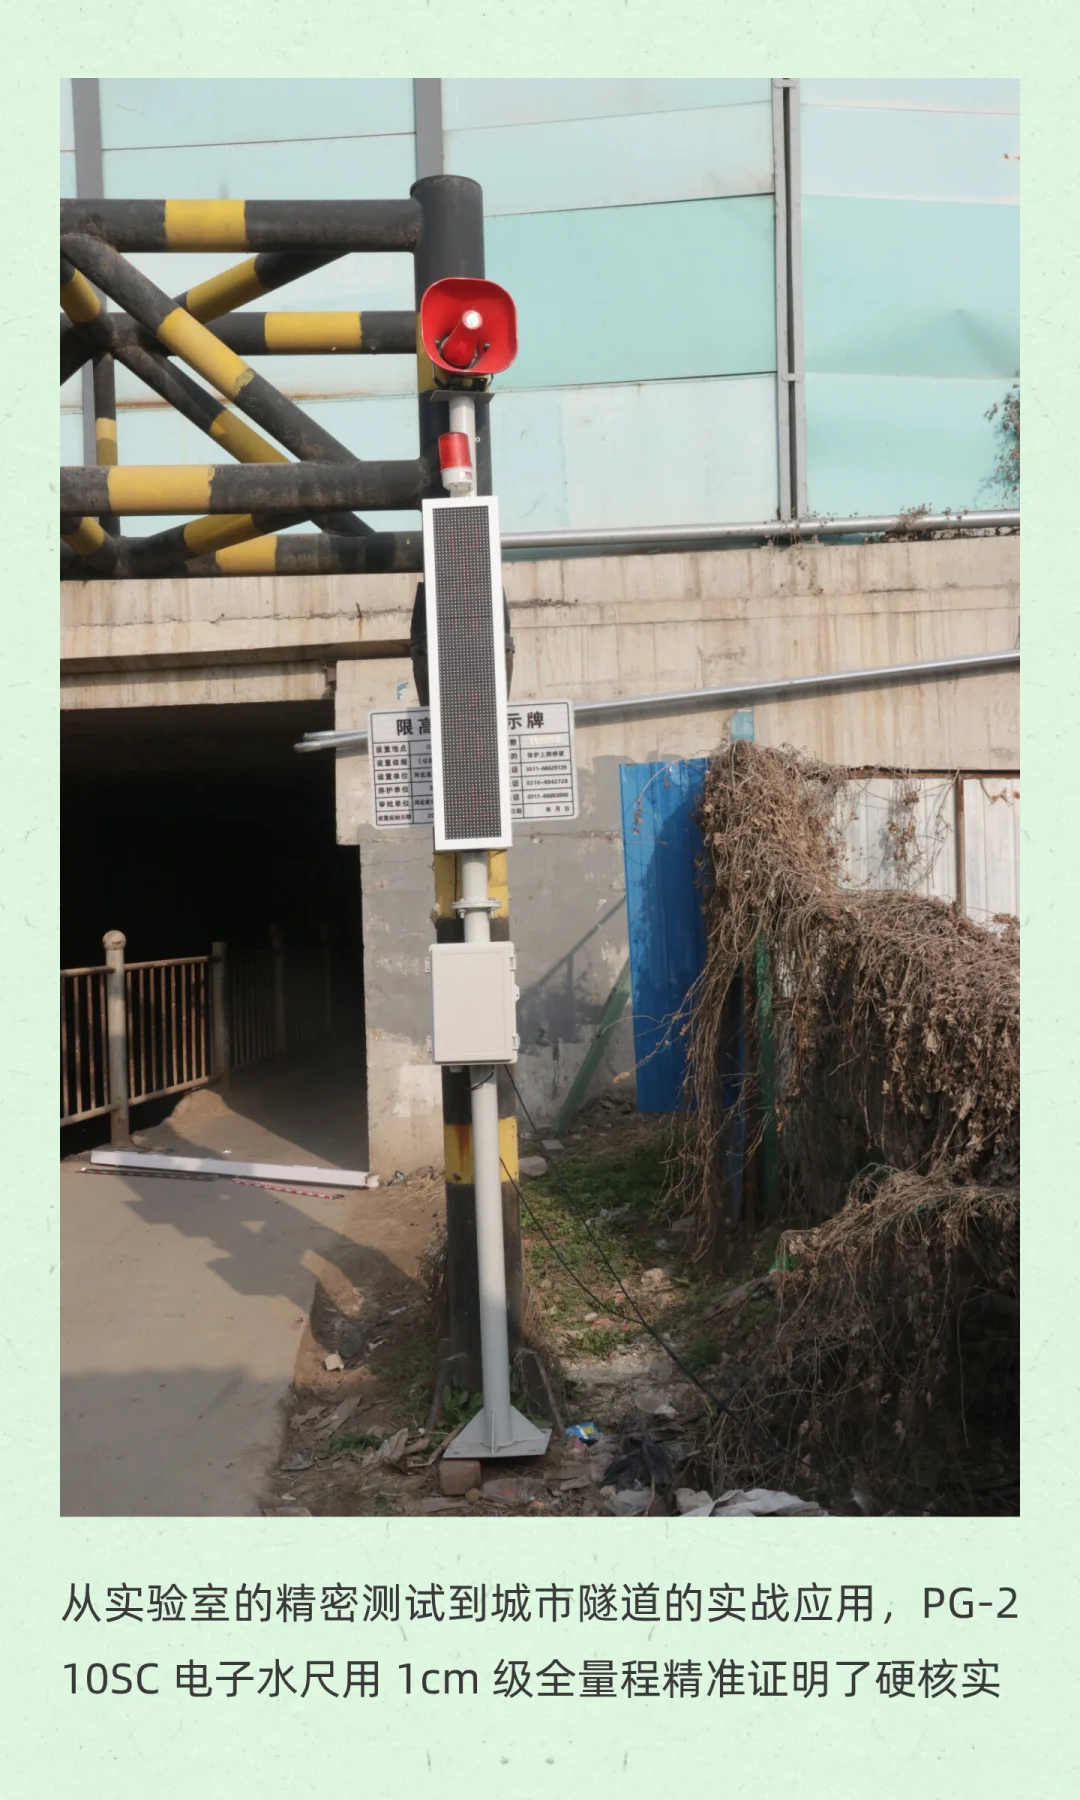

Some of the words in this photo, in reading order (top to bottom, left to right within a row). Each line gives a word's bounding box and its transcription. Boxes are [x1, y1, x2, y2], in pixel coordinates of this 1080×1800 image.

[376, 744, 406, 754] 设置地点
[378, 772, 409, 781] 设置单位
[378, 785, 409, 795] 养护单位
[379, 799, 410, 808] 审批单位
